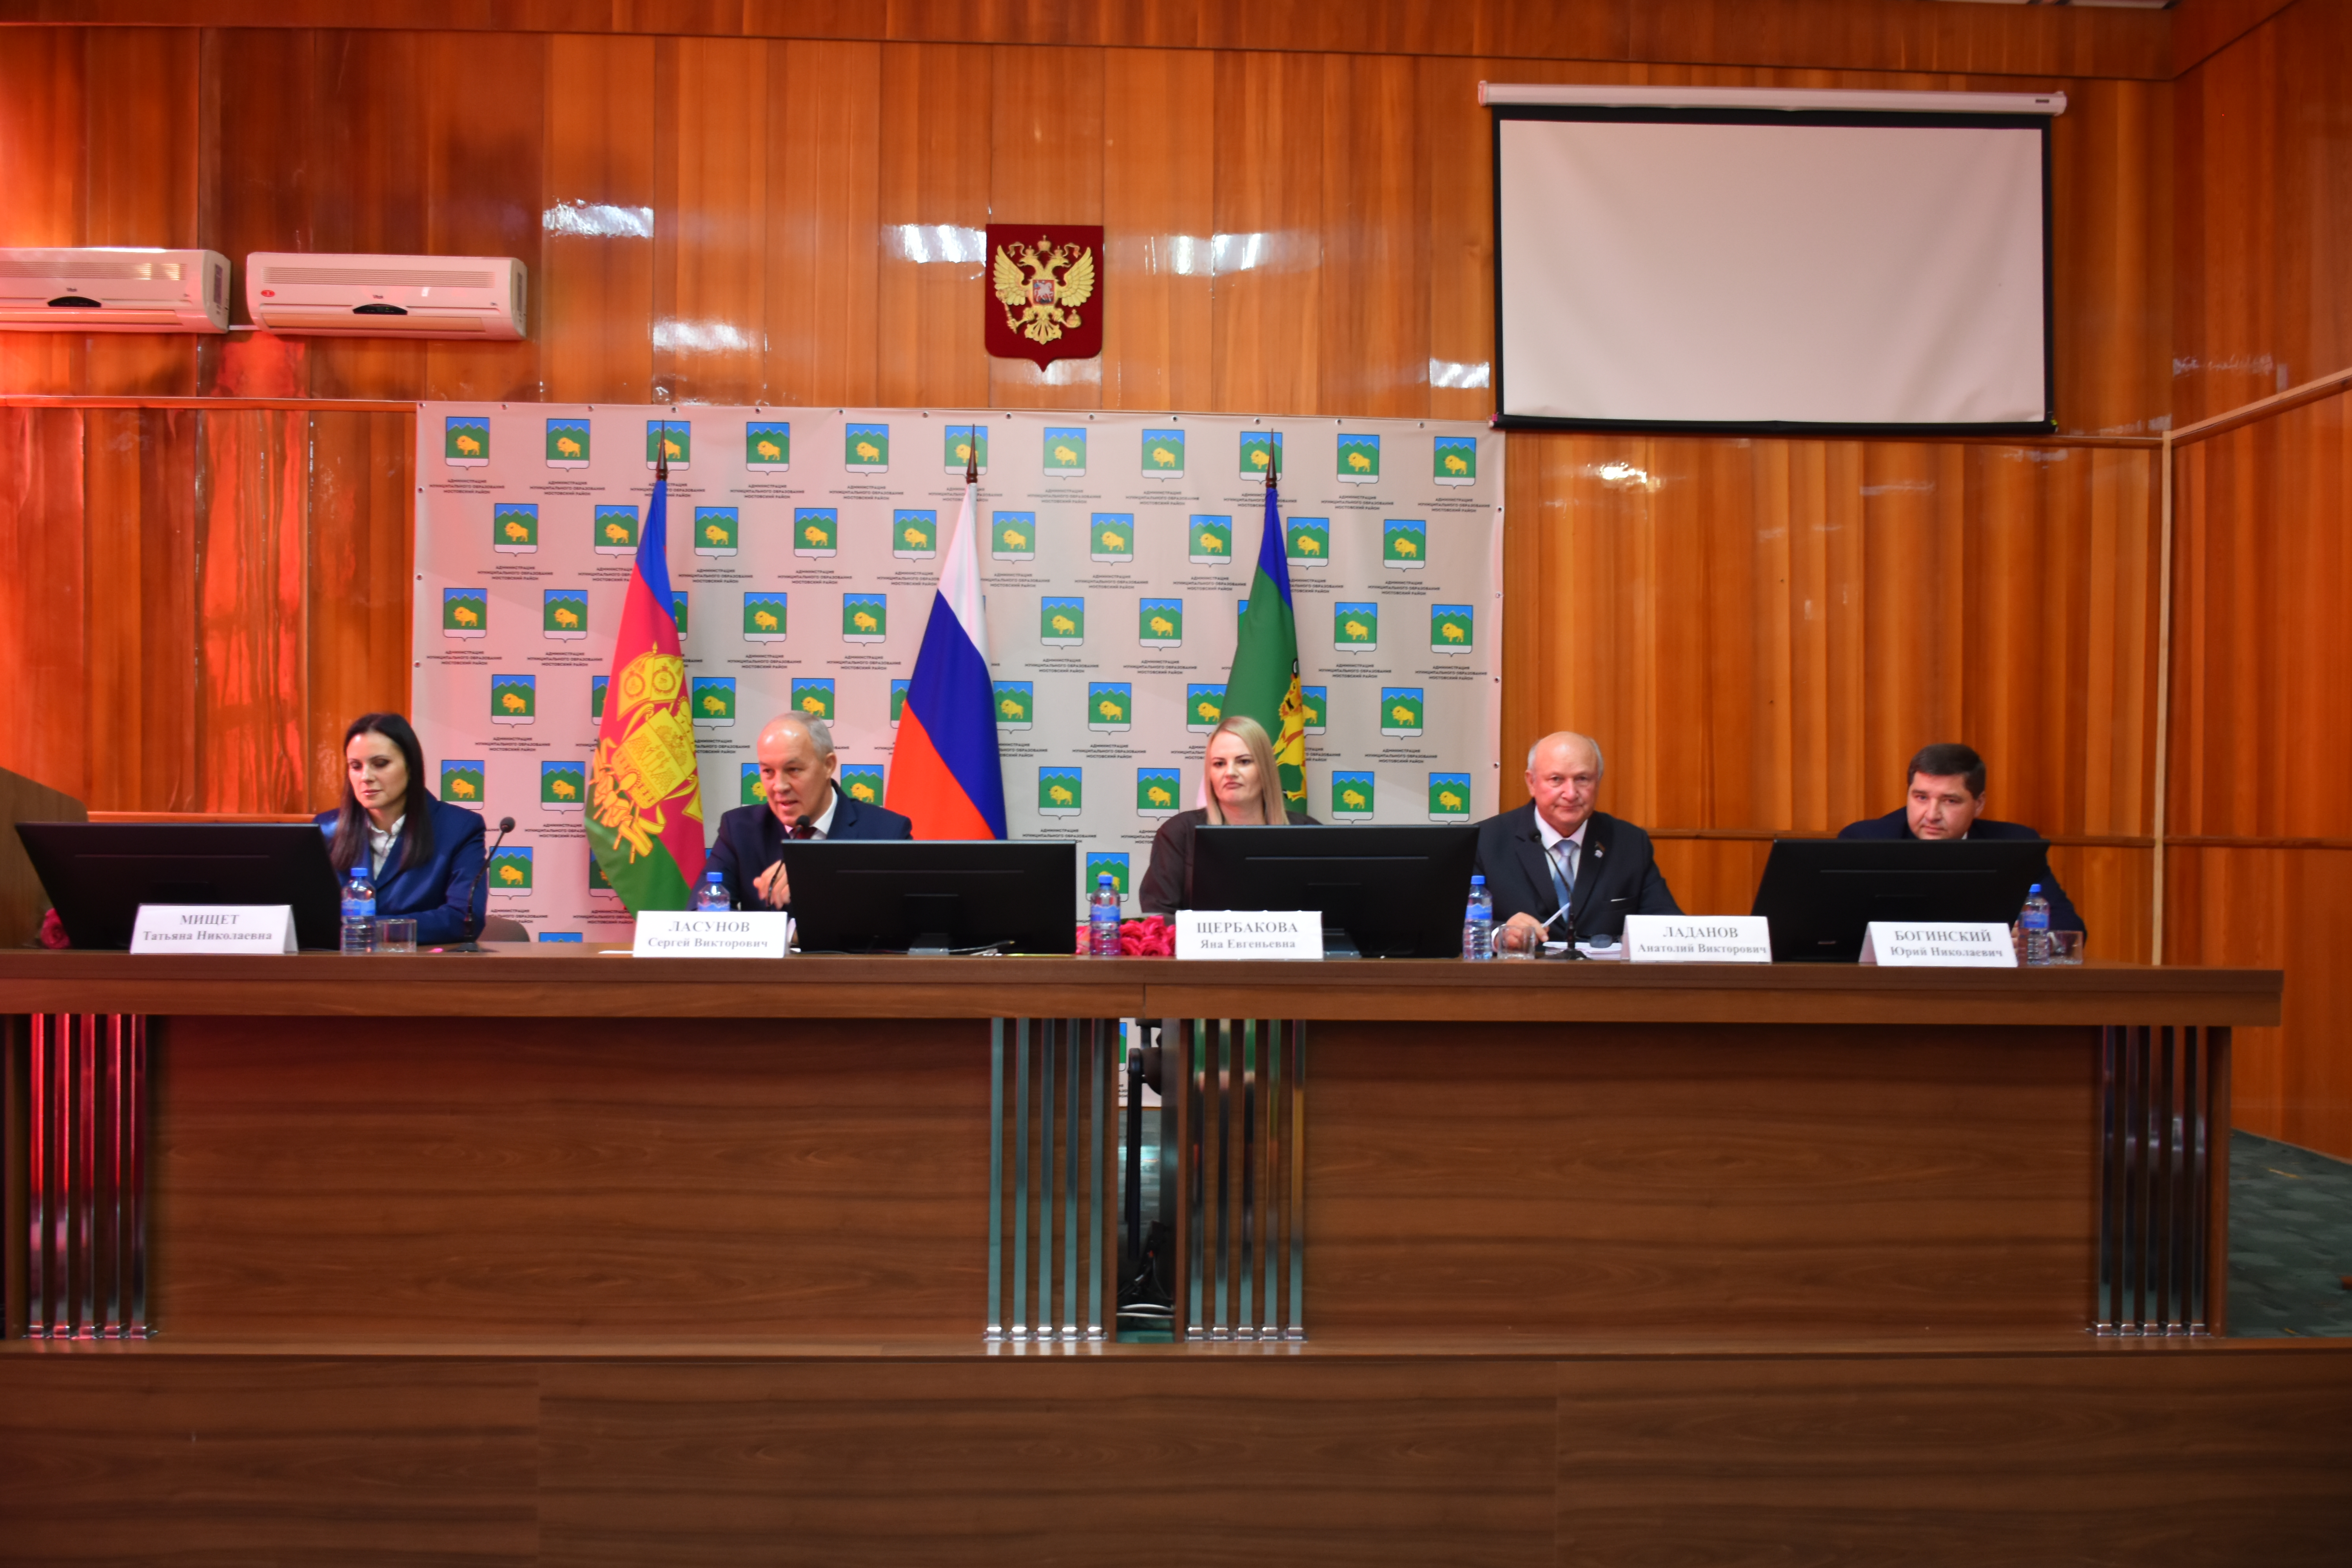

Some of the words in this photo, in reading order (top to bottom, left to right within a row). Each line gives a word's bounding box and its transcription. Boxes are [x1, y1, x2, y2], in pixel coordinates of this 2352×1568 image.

[180, 915, 240, 926] МИЩЕТ
[668, 921, 750, 932] ЛАСУНОВ
[1197, 922, 1298, 934] ЩЕРБАКОВА
[1662, 926, 1739, 938] ЛАДАНОВ
[143, 931, 193, 940] Татьяна
[196, 930, 272, 940] Николаевна
[1895, 929, 1992, 942] БОГИНСКИЙ
[648, 937, 690, 949] Сергей
[694, 938, 768, 949] Викторович
[1200, 939, 1223, 949] Яна
[1227, 939, 1296, 949] Евгеньевна
[1638, 943, 1694, 953] Анатолий
[1698, 943, 1767, 955] Викторович
[1890, 946, 1927, 958] Юрий
[1931, 947, 2003, 957] Николаевич
